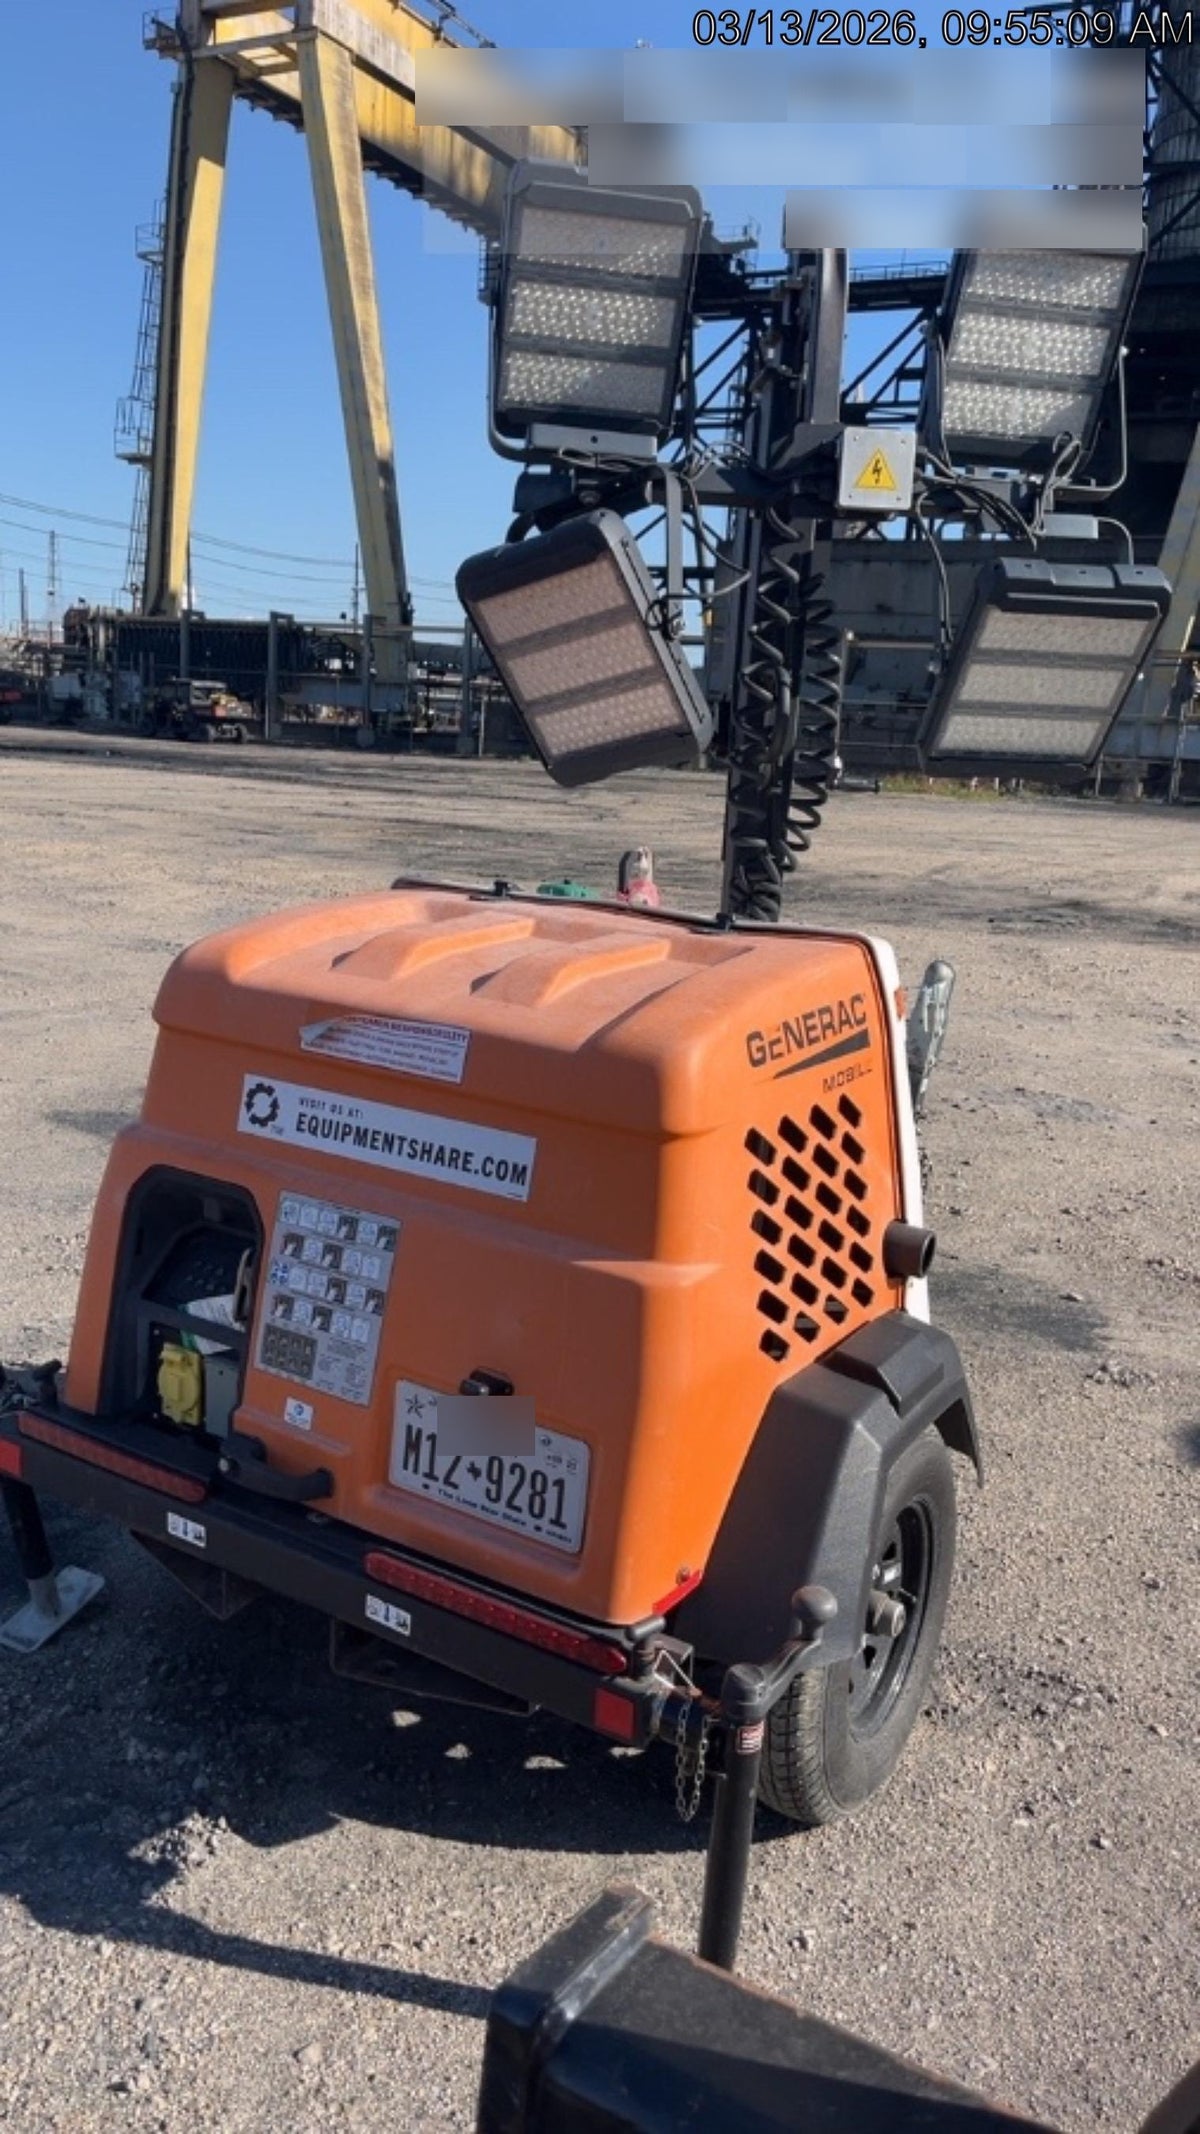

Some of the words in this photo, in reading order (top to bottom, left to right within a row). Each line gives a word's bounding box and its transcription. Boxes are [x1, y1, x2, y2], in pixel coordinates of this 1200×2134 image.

[746, 993, 867, 1067] GENERAC
[299, 1097, 326, 1111] VISIT
[296, 1112, 529, 1187] EQUIPMENTSHARE.COM
